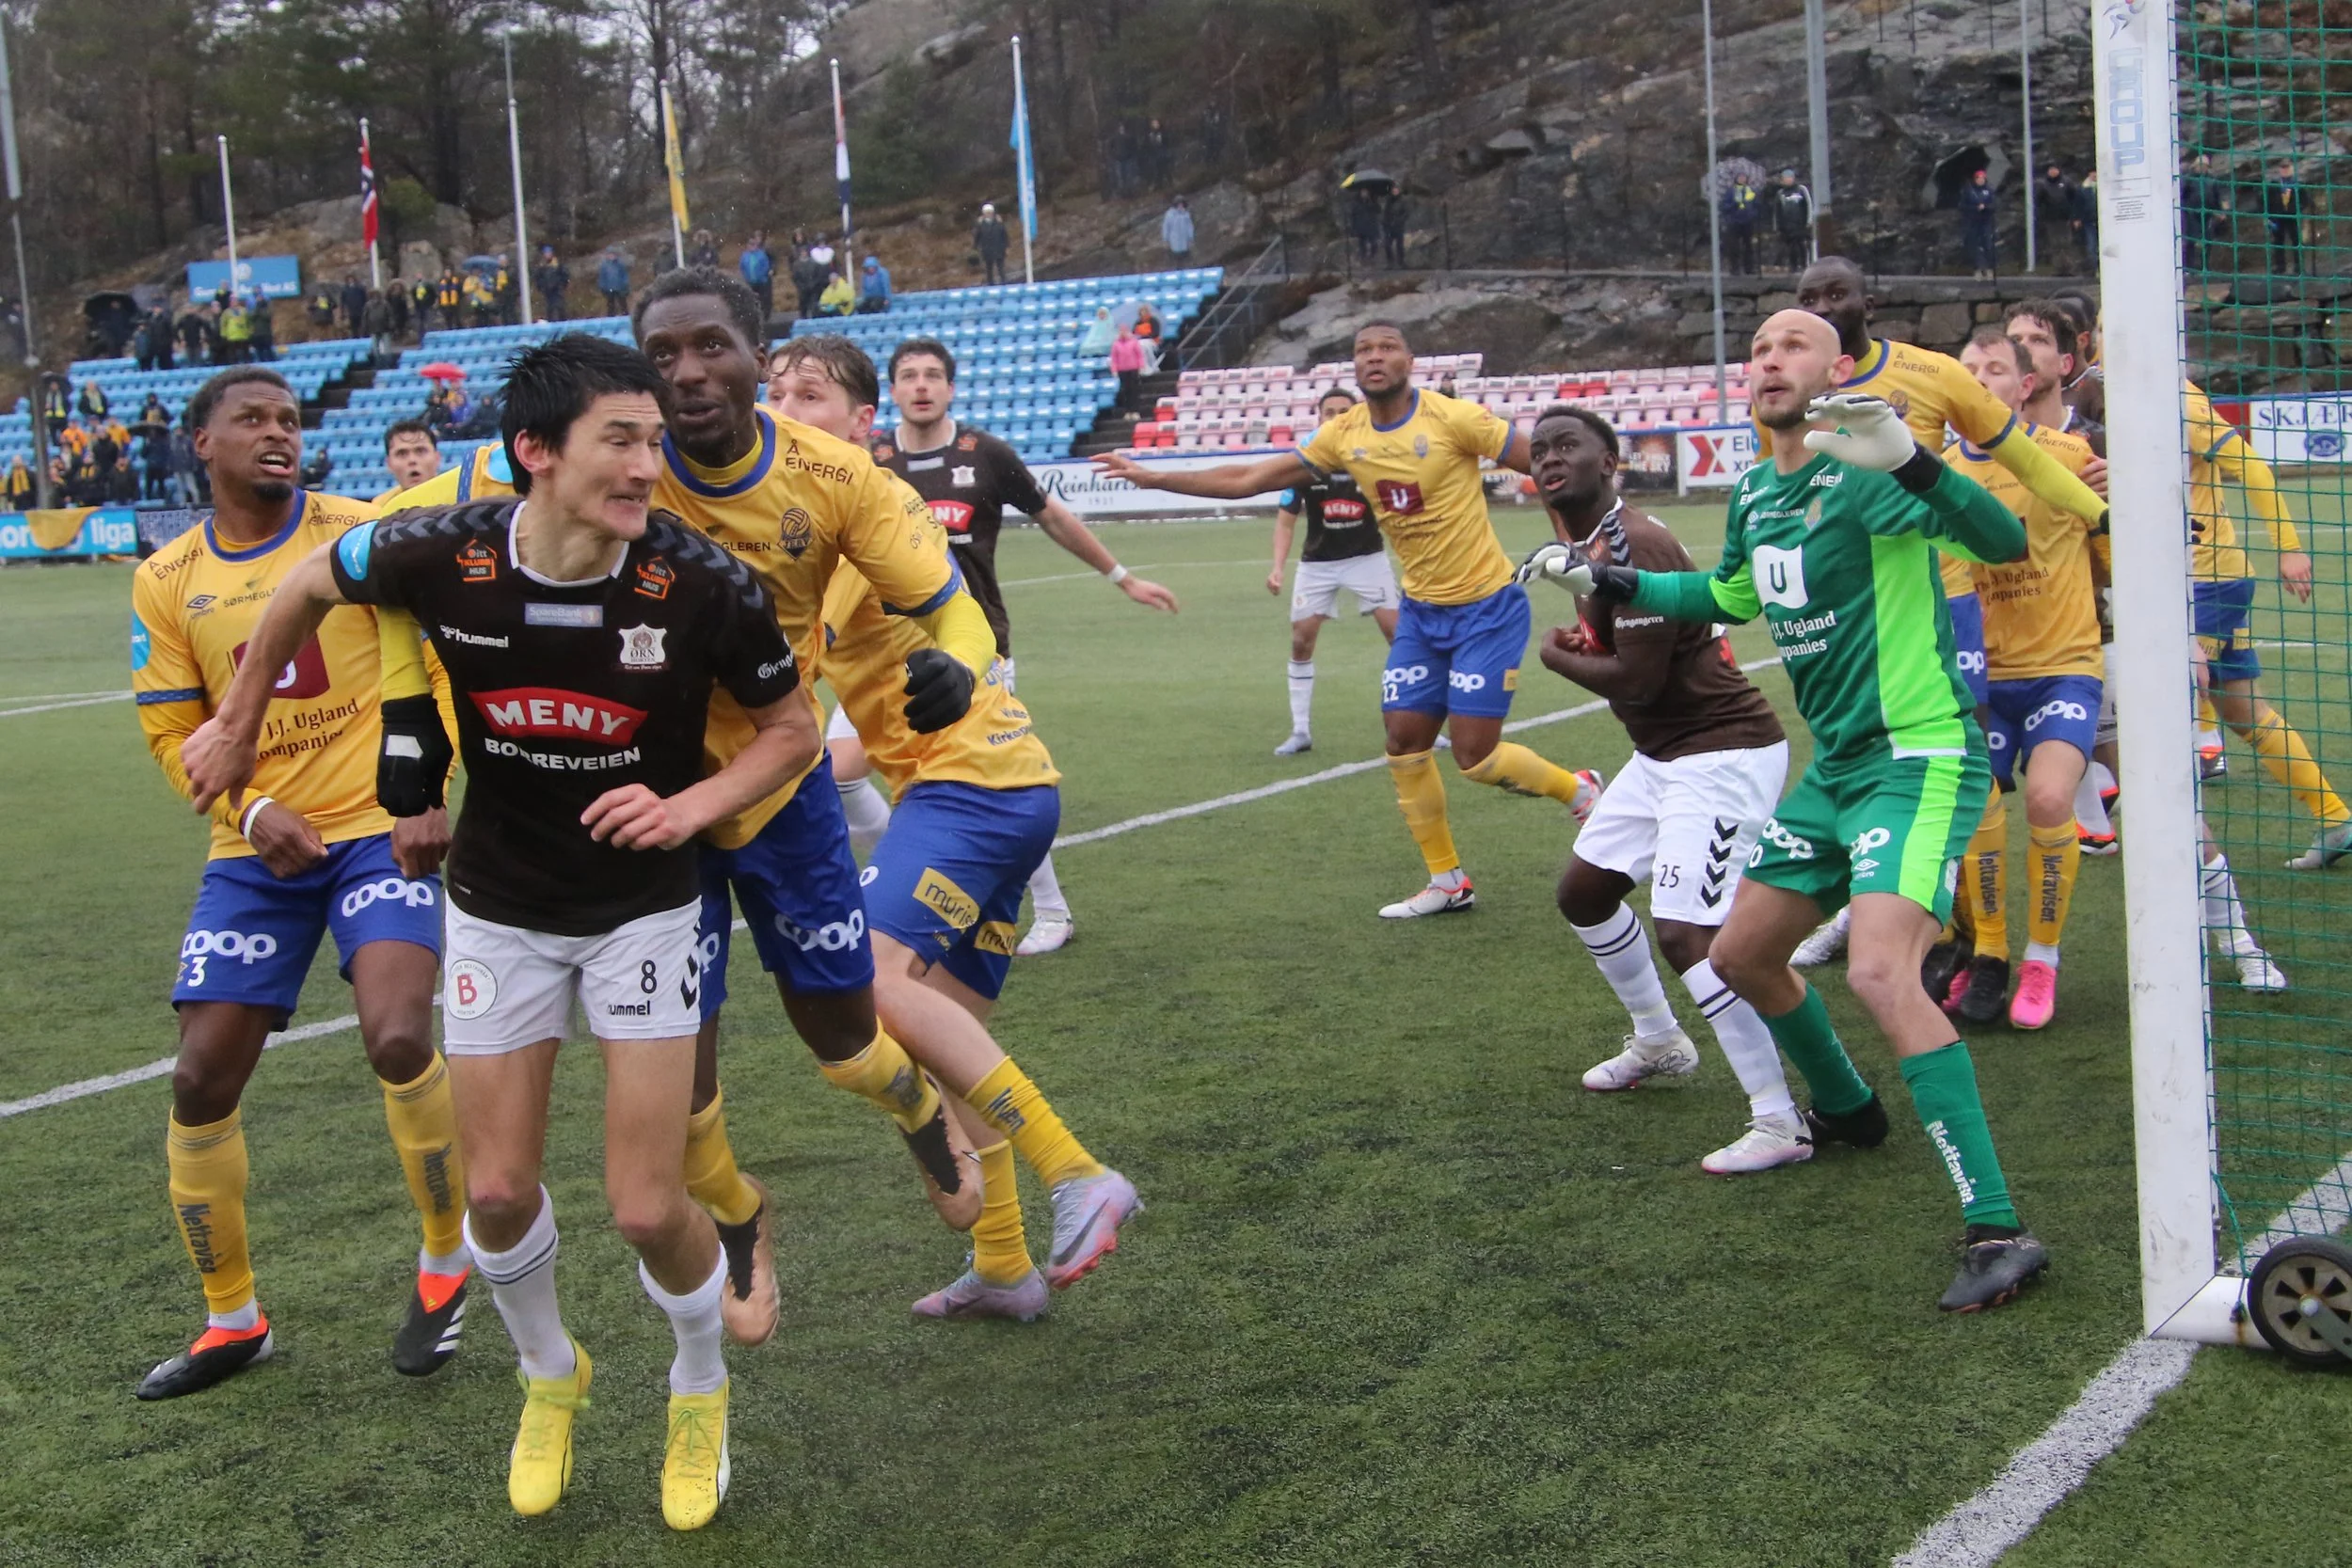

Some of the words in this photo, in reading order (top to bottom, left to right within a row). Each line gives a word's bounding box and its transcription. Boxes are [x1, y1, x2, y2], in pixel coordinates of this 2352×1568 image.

[1893, 360, 1940, 373] ENERGI
[787, 438, 799, 454] Å
[786, 457, 853, 485] ENERGI
[1391, 488, 1408, 509] U
[90, 517, 135, 549] liga
[309, 515, 359, 527] ENERGI
[1770, 562, 1787, 594] U
[456, 629, 509, 648] hummel
[1785, 610, 1836, 638] Ugland
[630, 648, 655, 658] ØRN
[294, 698, 359, 730] Ugland
[485, 699, 629, 736] MENY
[2025, 700, 2087, 732] coop
[485, 738, 641, 770] BORREVEIEN
[1659, 864, 1681, 889] 25
[342, 878, 434, 917] coop
[183, 929, 277, 964] coop
[188, 957, 208, 987] 3
[641, 959, 657, 994] 8
[457, 974, 477, 1006] B
